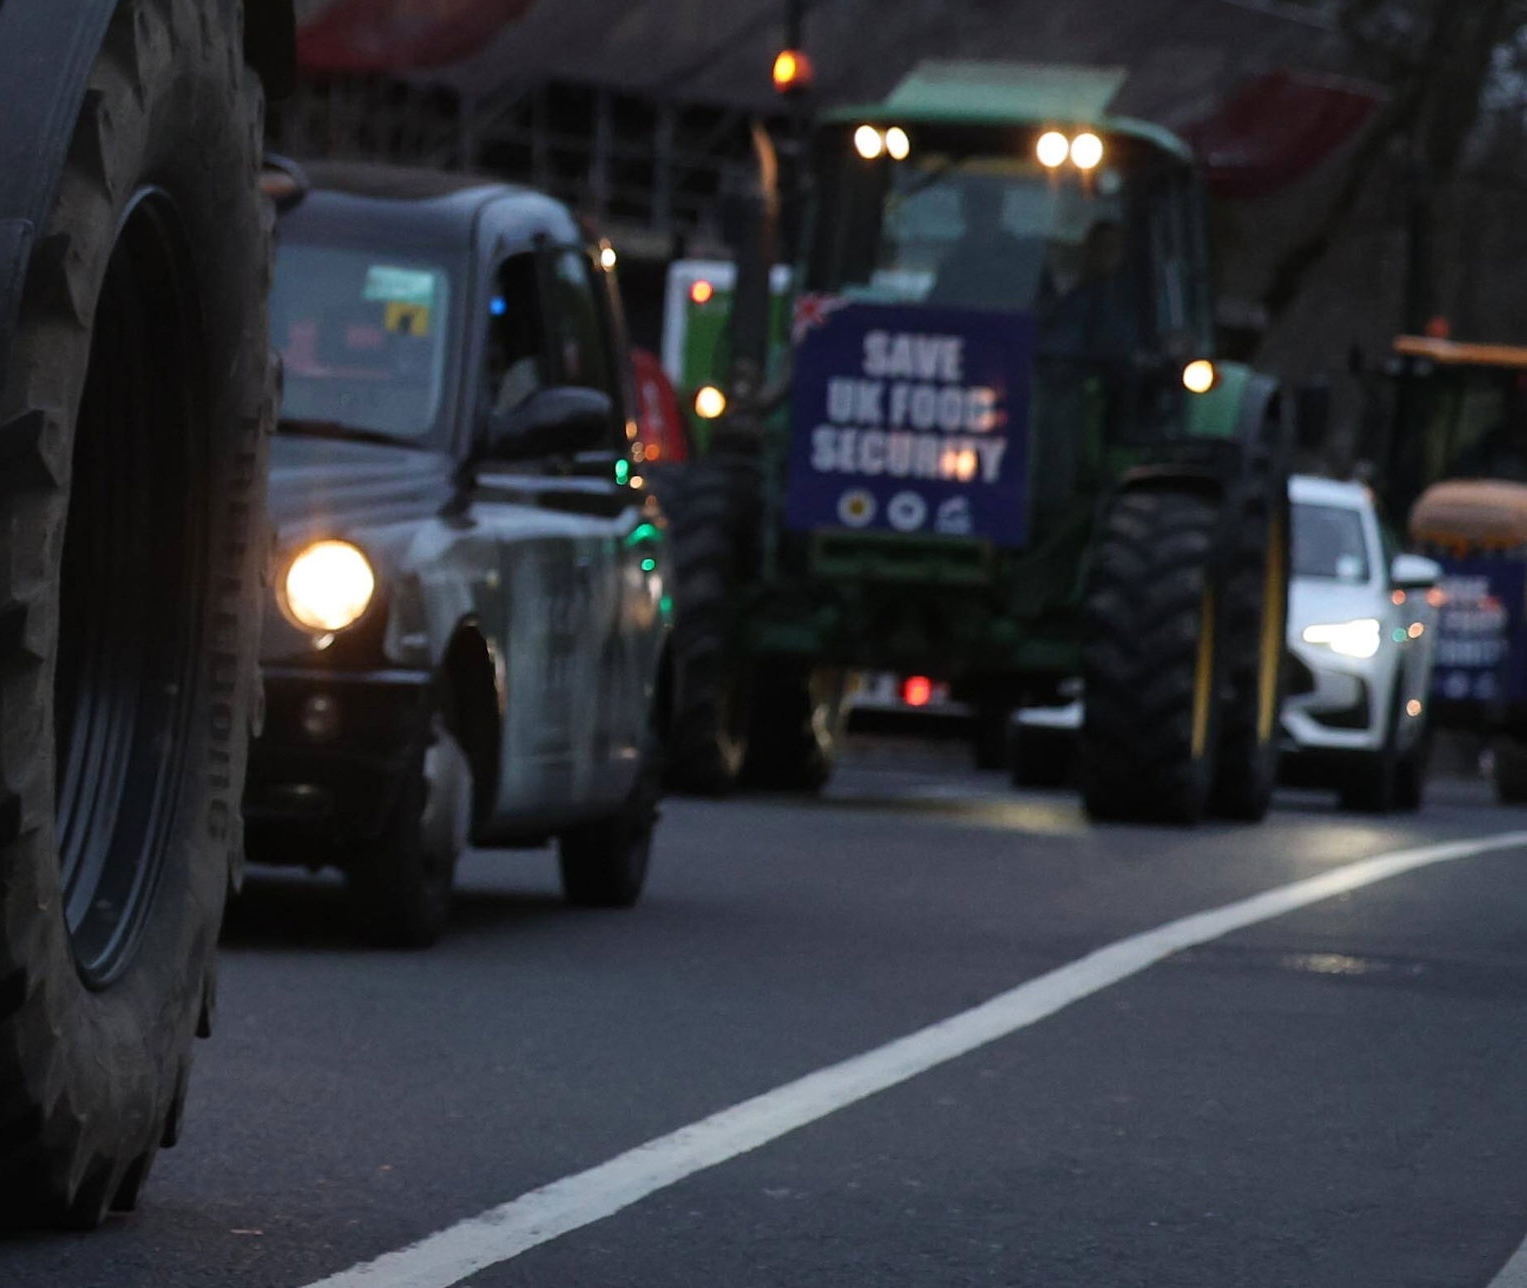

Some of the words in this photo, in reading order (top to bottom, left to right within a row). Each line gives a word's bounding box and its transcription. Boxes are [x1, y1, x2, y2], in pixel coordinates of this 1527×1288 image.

[861, 329, 965, 380] SAVE
[826, 375, 884, 424] UK
[888, 381, 998, 433] FOOD
[810, 423, 1009, 484] SECURITY
